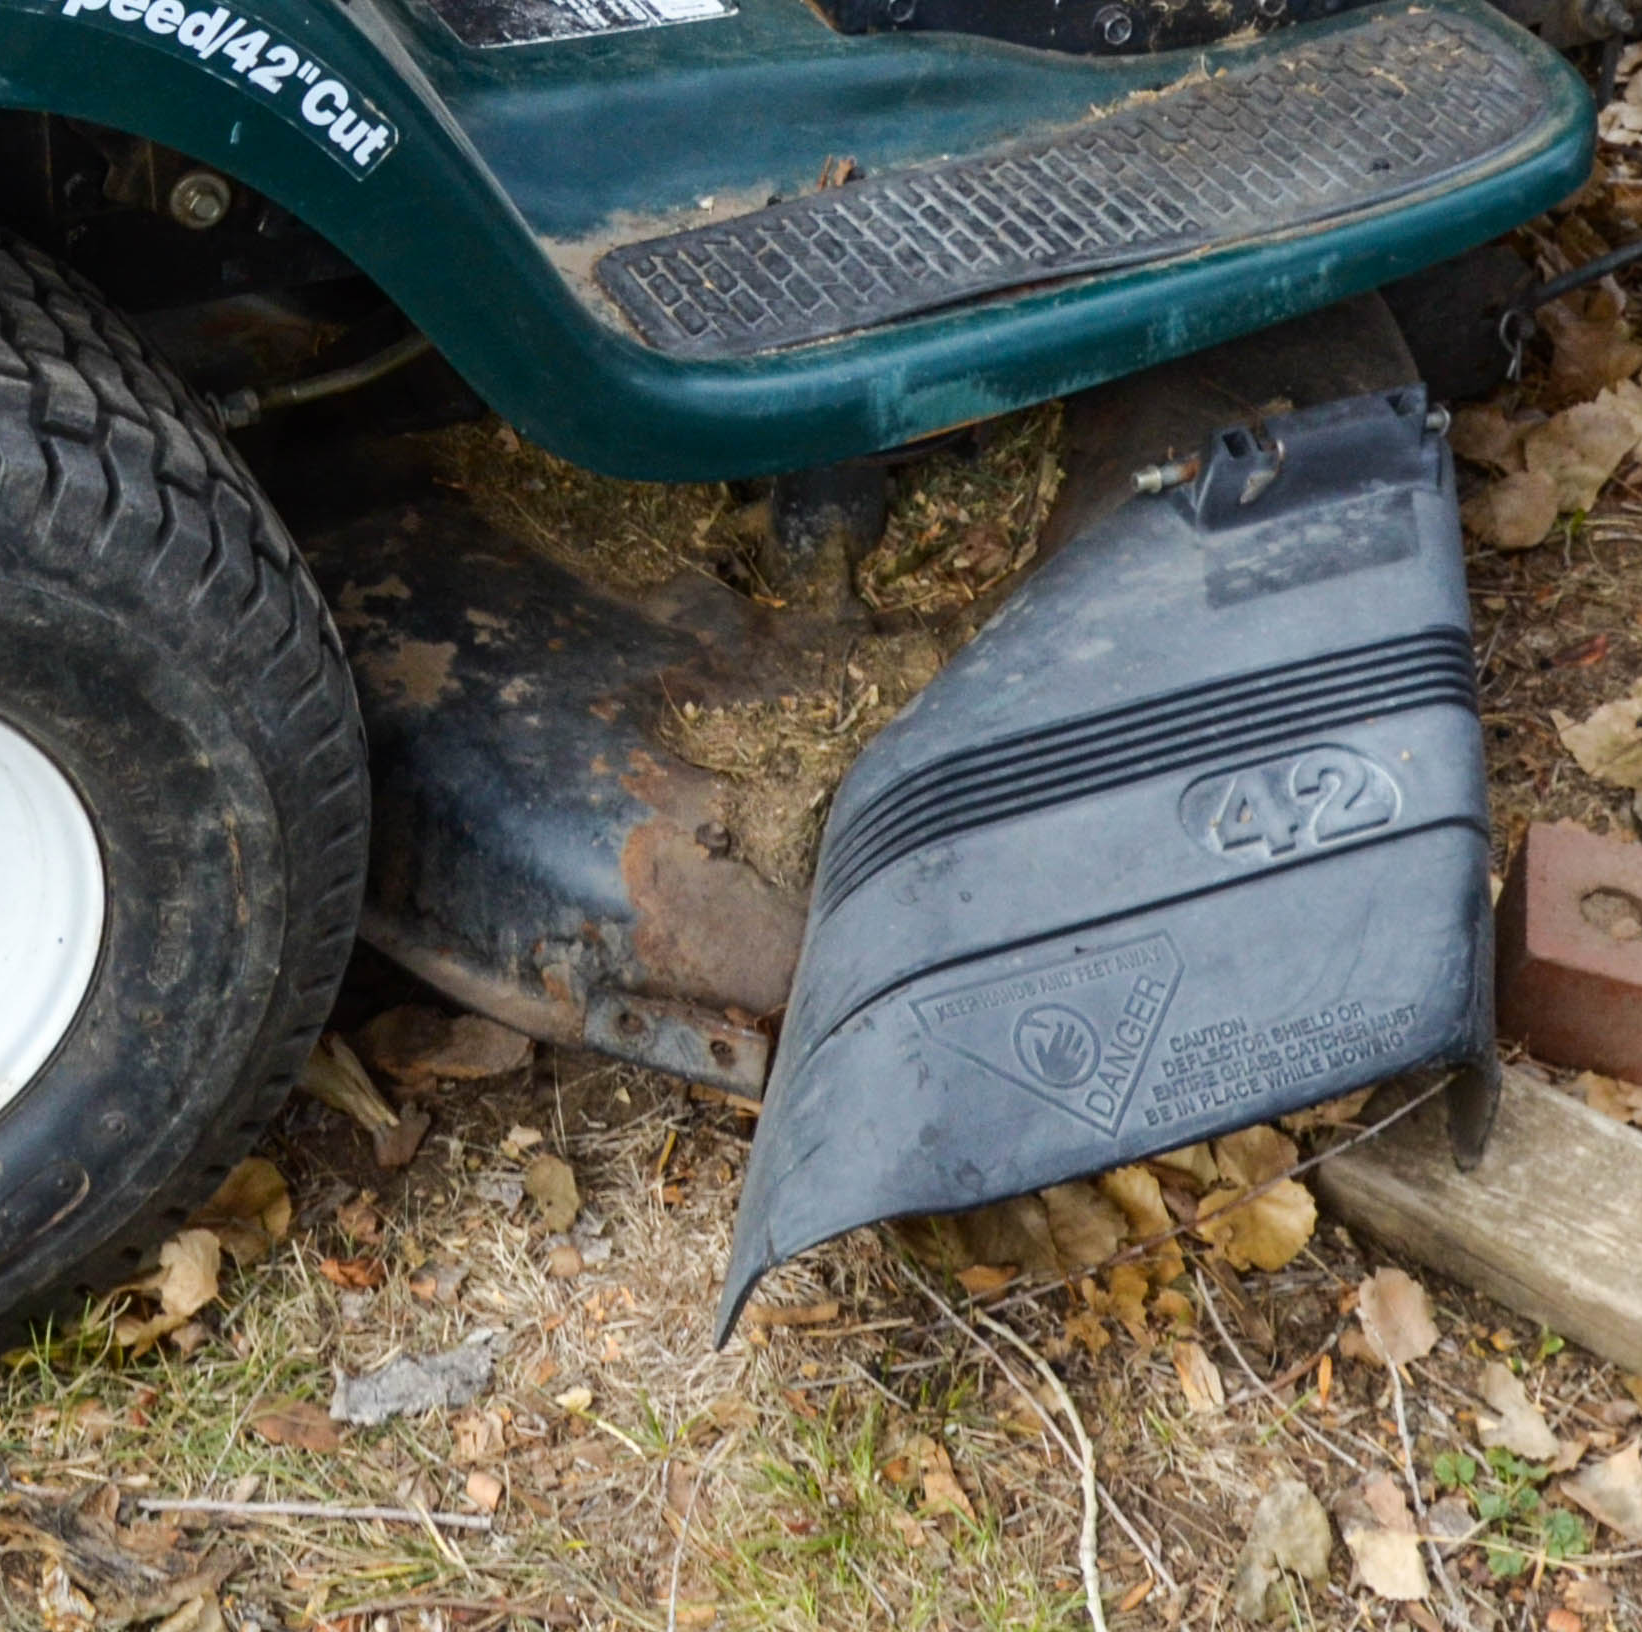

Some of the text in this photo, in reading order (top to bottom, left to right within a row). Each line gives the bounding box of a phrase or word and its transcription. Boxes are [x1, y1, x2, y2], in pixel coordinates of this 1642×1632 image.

[1210, 749, 1391, 857] 42
[934, 997, 981, 1022] KEEP
[1039, 972, 1073, 995] AND
[1076, 960, 1112, 985] FEET
[1109, 943, 1163, 975] AWAY
[1084, 974, 1166, 1120] DANGER
[1143, 1031, 1406, 1128] BE IN PLACE WHILE MOWING
[1151, 1002, 1419, 1104] ENTIRE GRASS CATCHER MUST
[1160, 1001, 1365, 1079] DEFLECTOR SHIELD OR
[1169, 1016, 1247, 1053] CAUTION
